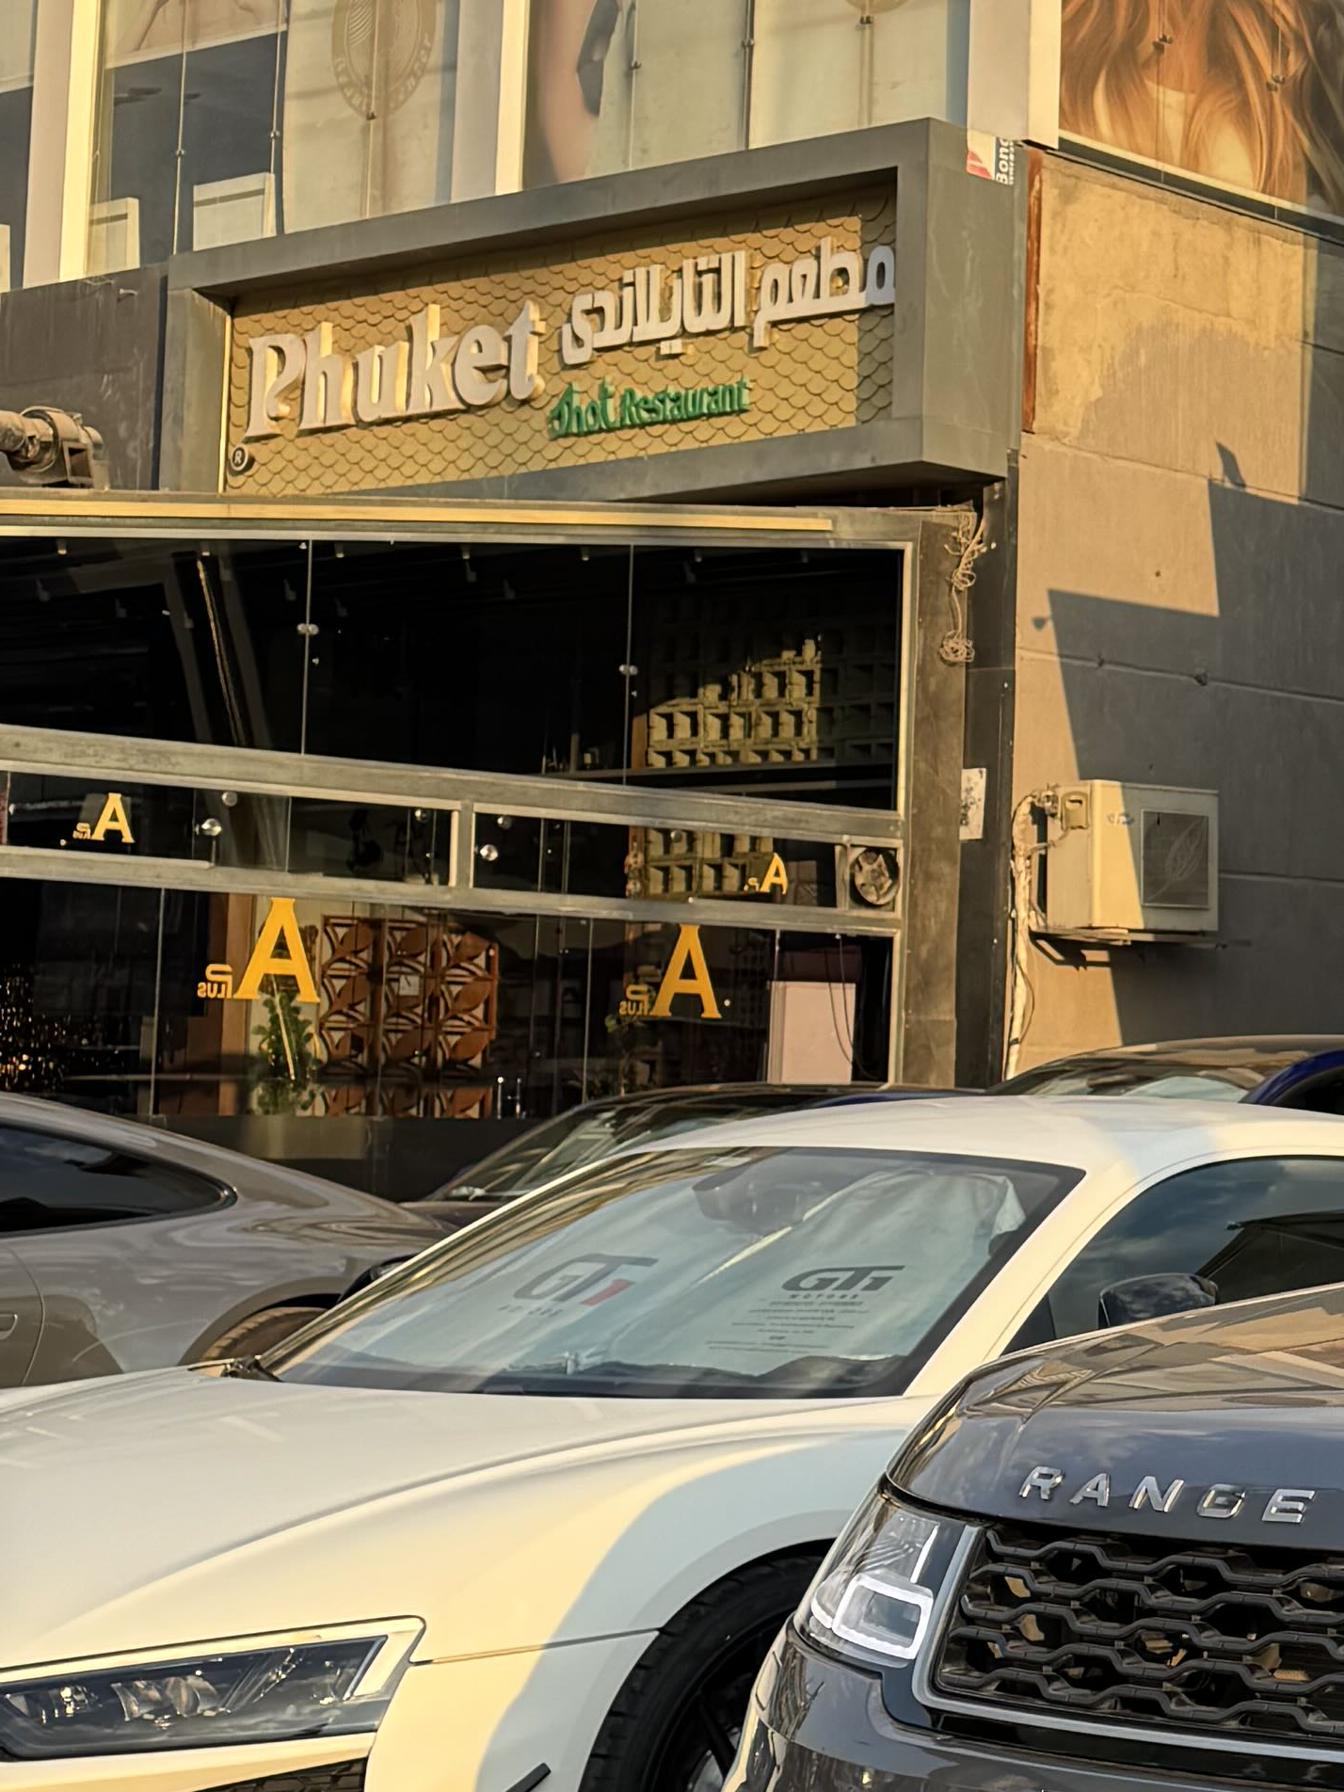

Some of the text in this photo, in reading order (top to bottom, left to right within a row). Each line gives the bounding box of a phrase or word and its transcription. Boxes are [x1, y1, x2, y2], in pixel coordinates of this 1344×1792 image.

[755, 238, 897, 350] مطعم
[244, 300, 547, 440] Phuket
[619, 373, 752, 426] Restaurant
[1018, 1465, 1315, 1525] RANGE
